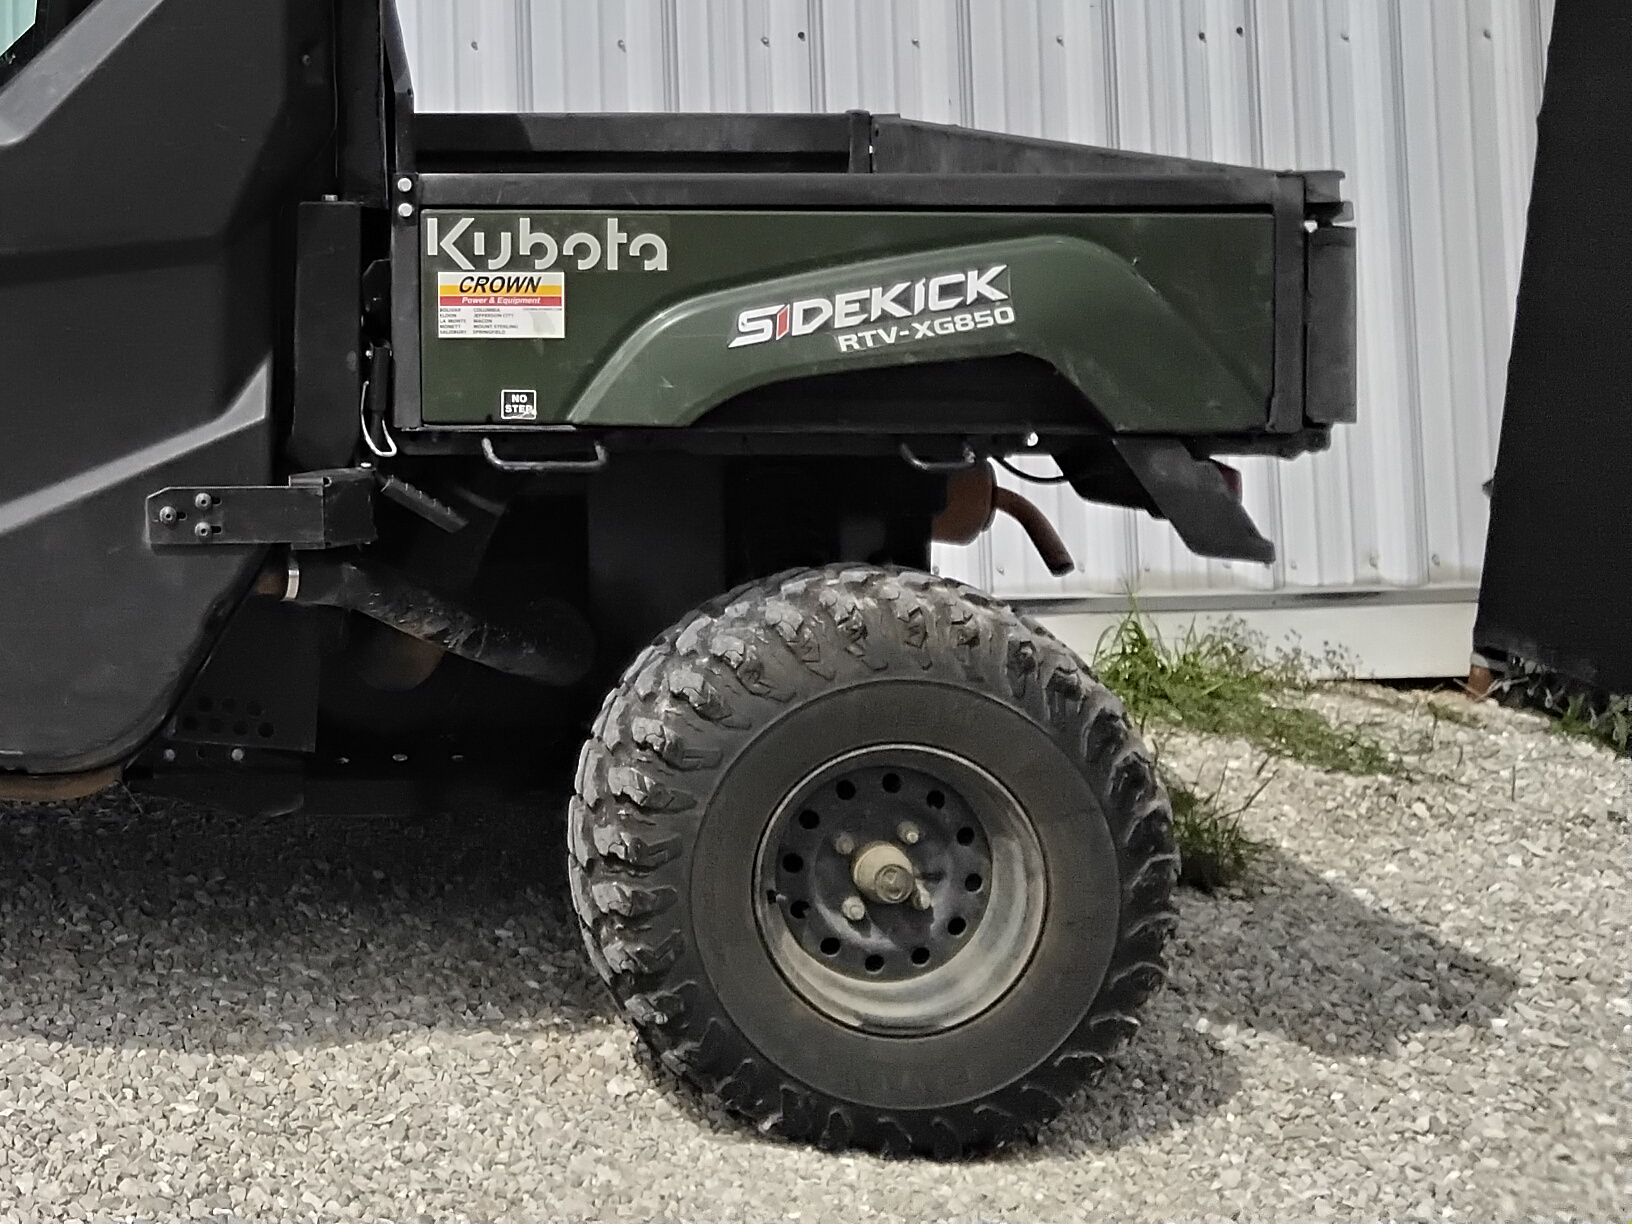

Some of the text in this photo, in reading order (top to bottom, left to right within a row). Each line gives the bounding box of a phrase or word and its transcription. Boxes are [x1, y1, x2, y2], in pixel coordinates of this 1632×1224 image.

[427, 217, 668, 271] Kubota
[459, 276, 542, 293] CROWN
[497, 297, 541, 306] Equipment
[727, 264, 1009, 348] SIDEKICK
[838, 306, 1015, 352] RTV-XG850
[511, 394, 528, 403] NO
[505, 404, 533, 414] STEP
